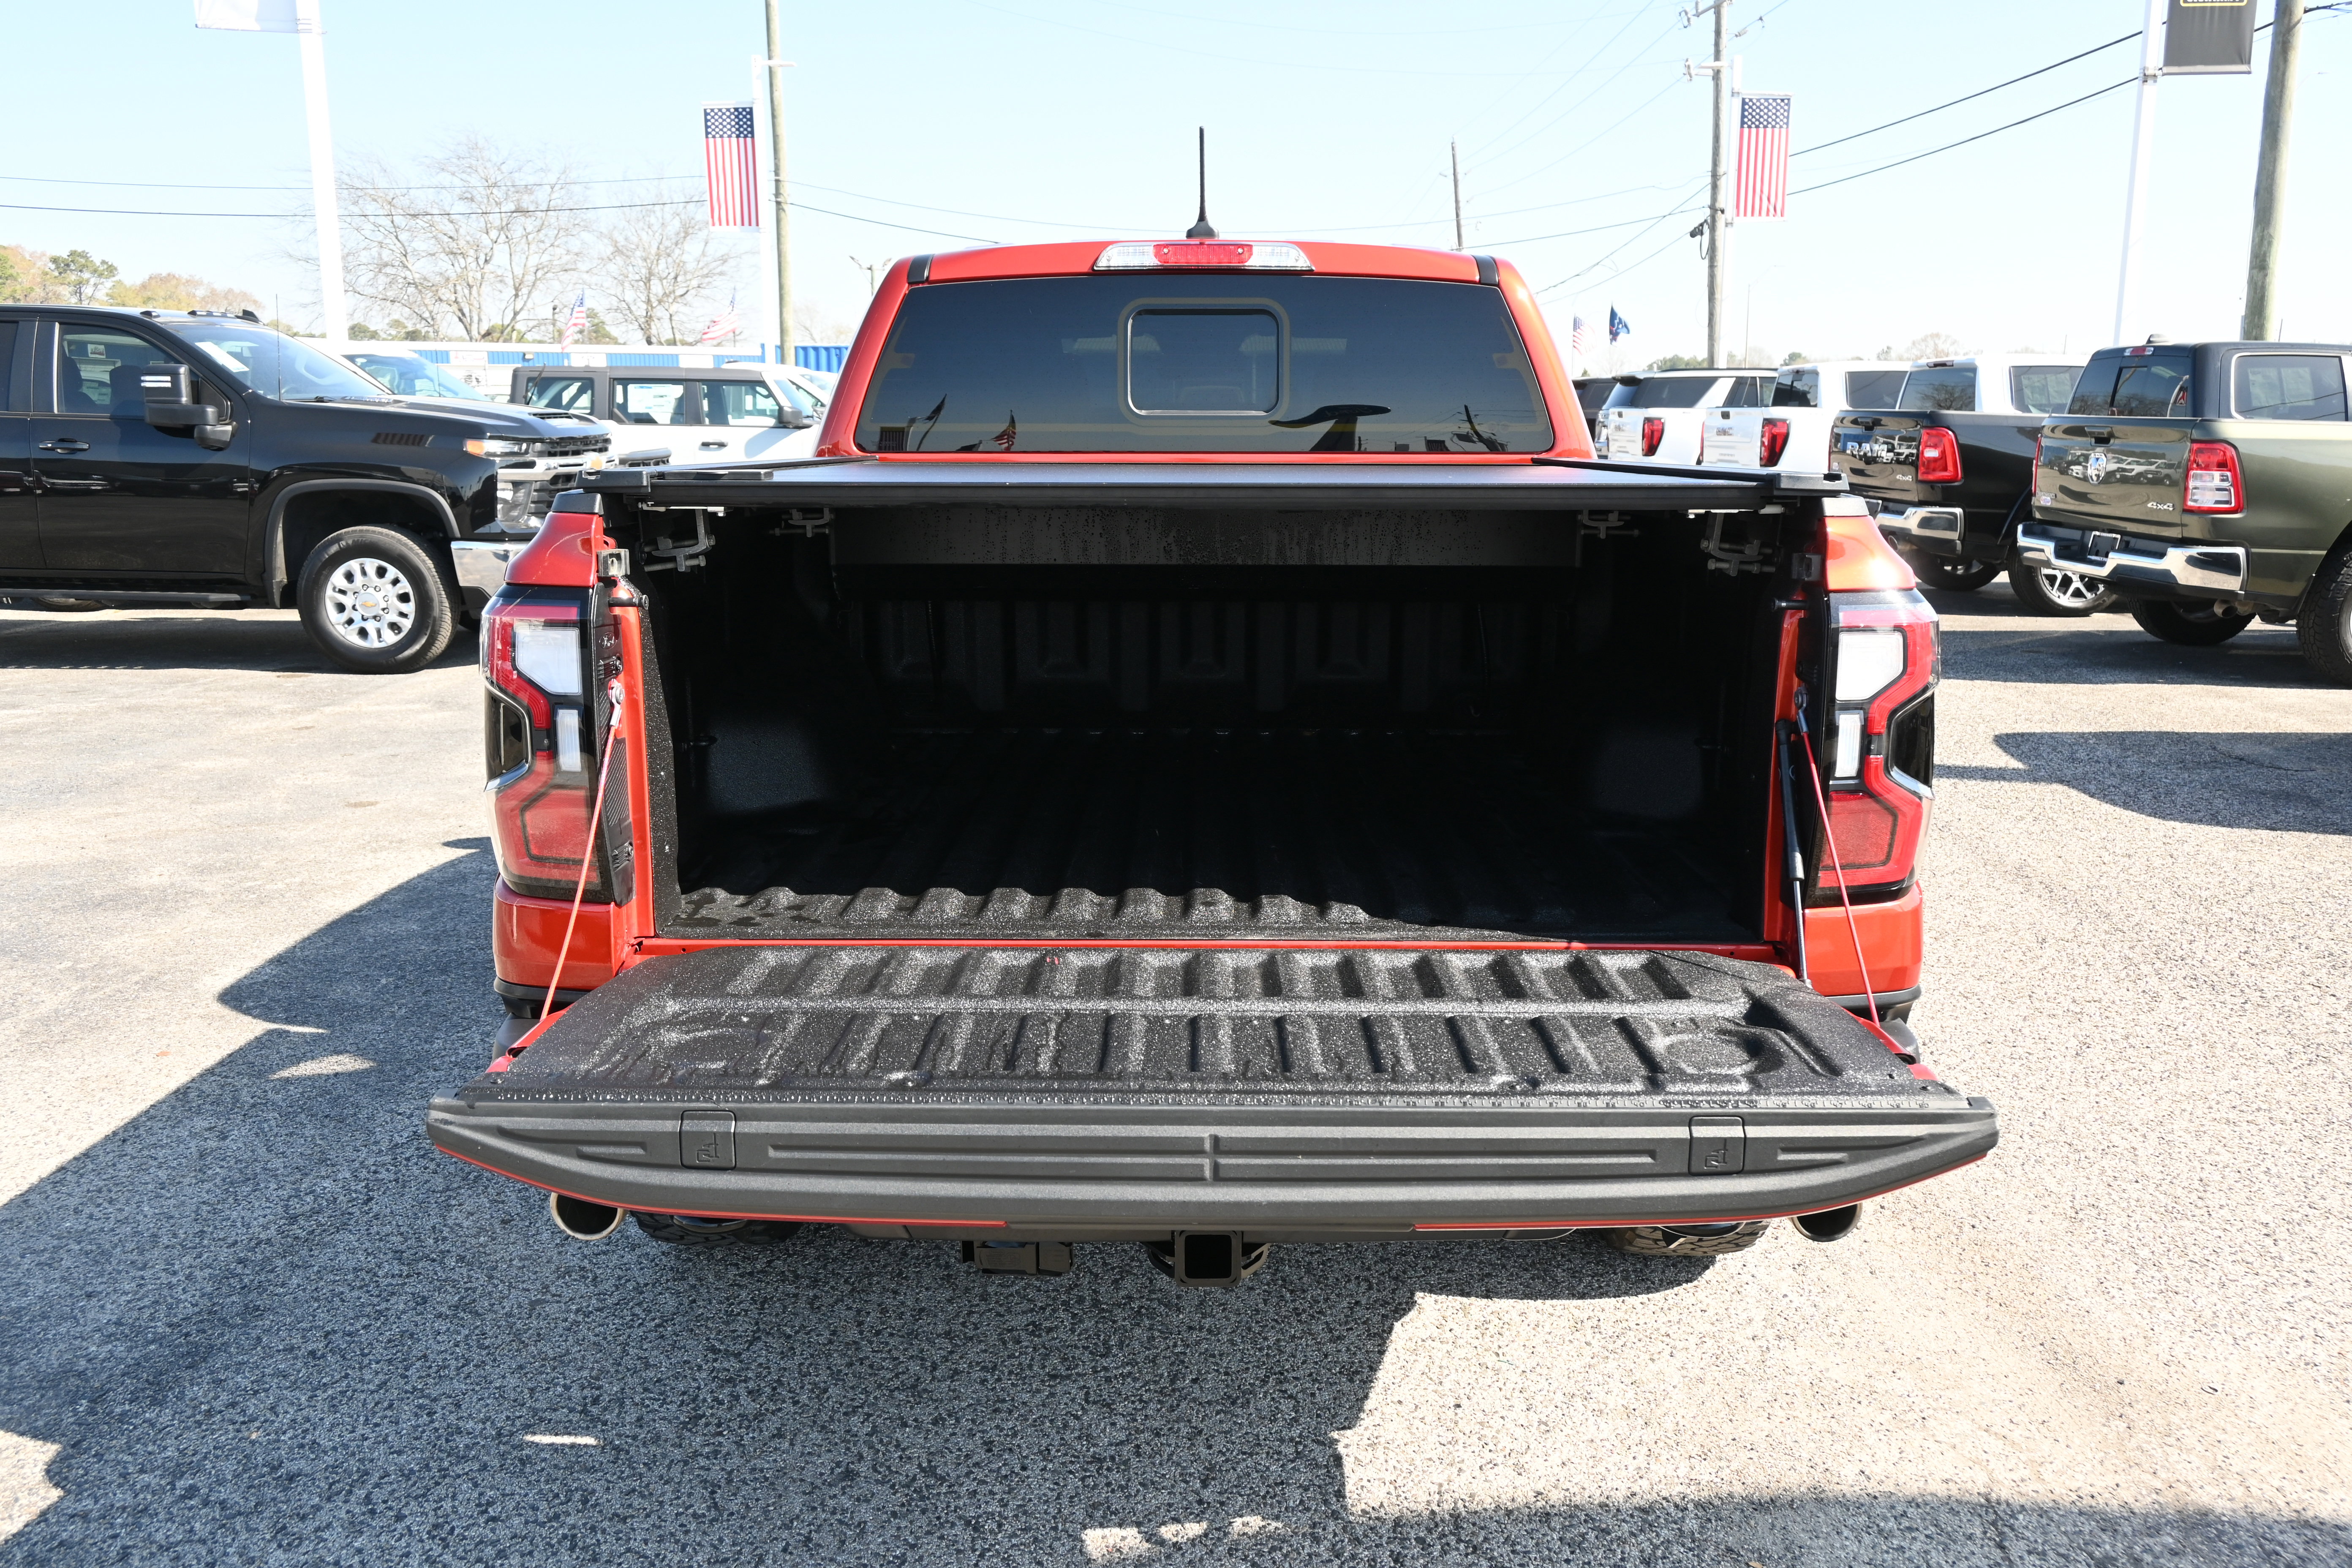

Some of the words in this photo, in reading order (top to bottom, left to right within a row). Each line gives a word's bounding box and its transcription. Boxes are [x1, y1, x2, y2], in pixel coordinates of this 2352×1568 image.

[1716, 427, 1734, 436] GMC
[1846, 442, 1888, 457] RAM
[2147, 501, 2174, 511] 4x4
